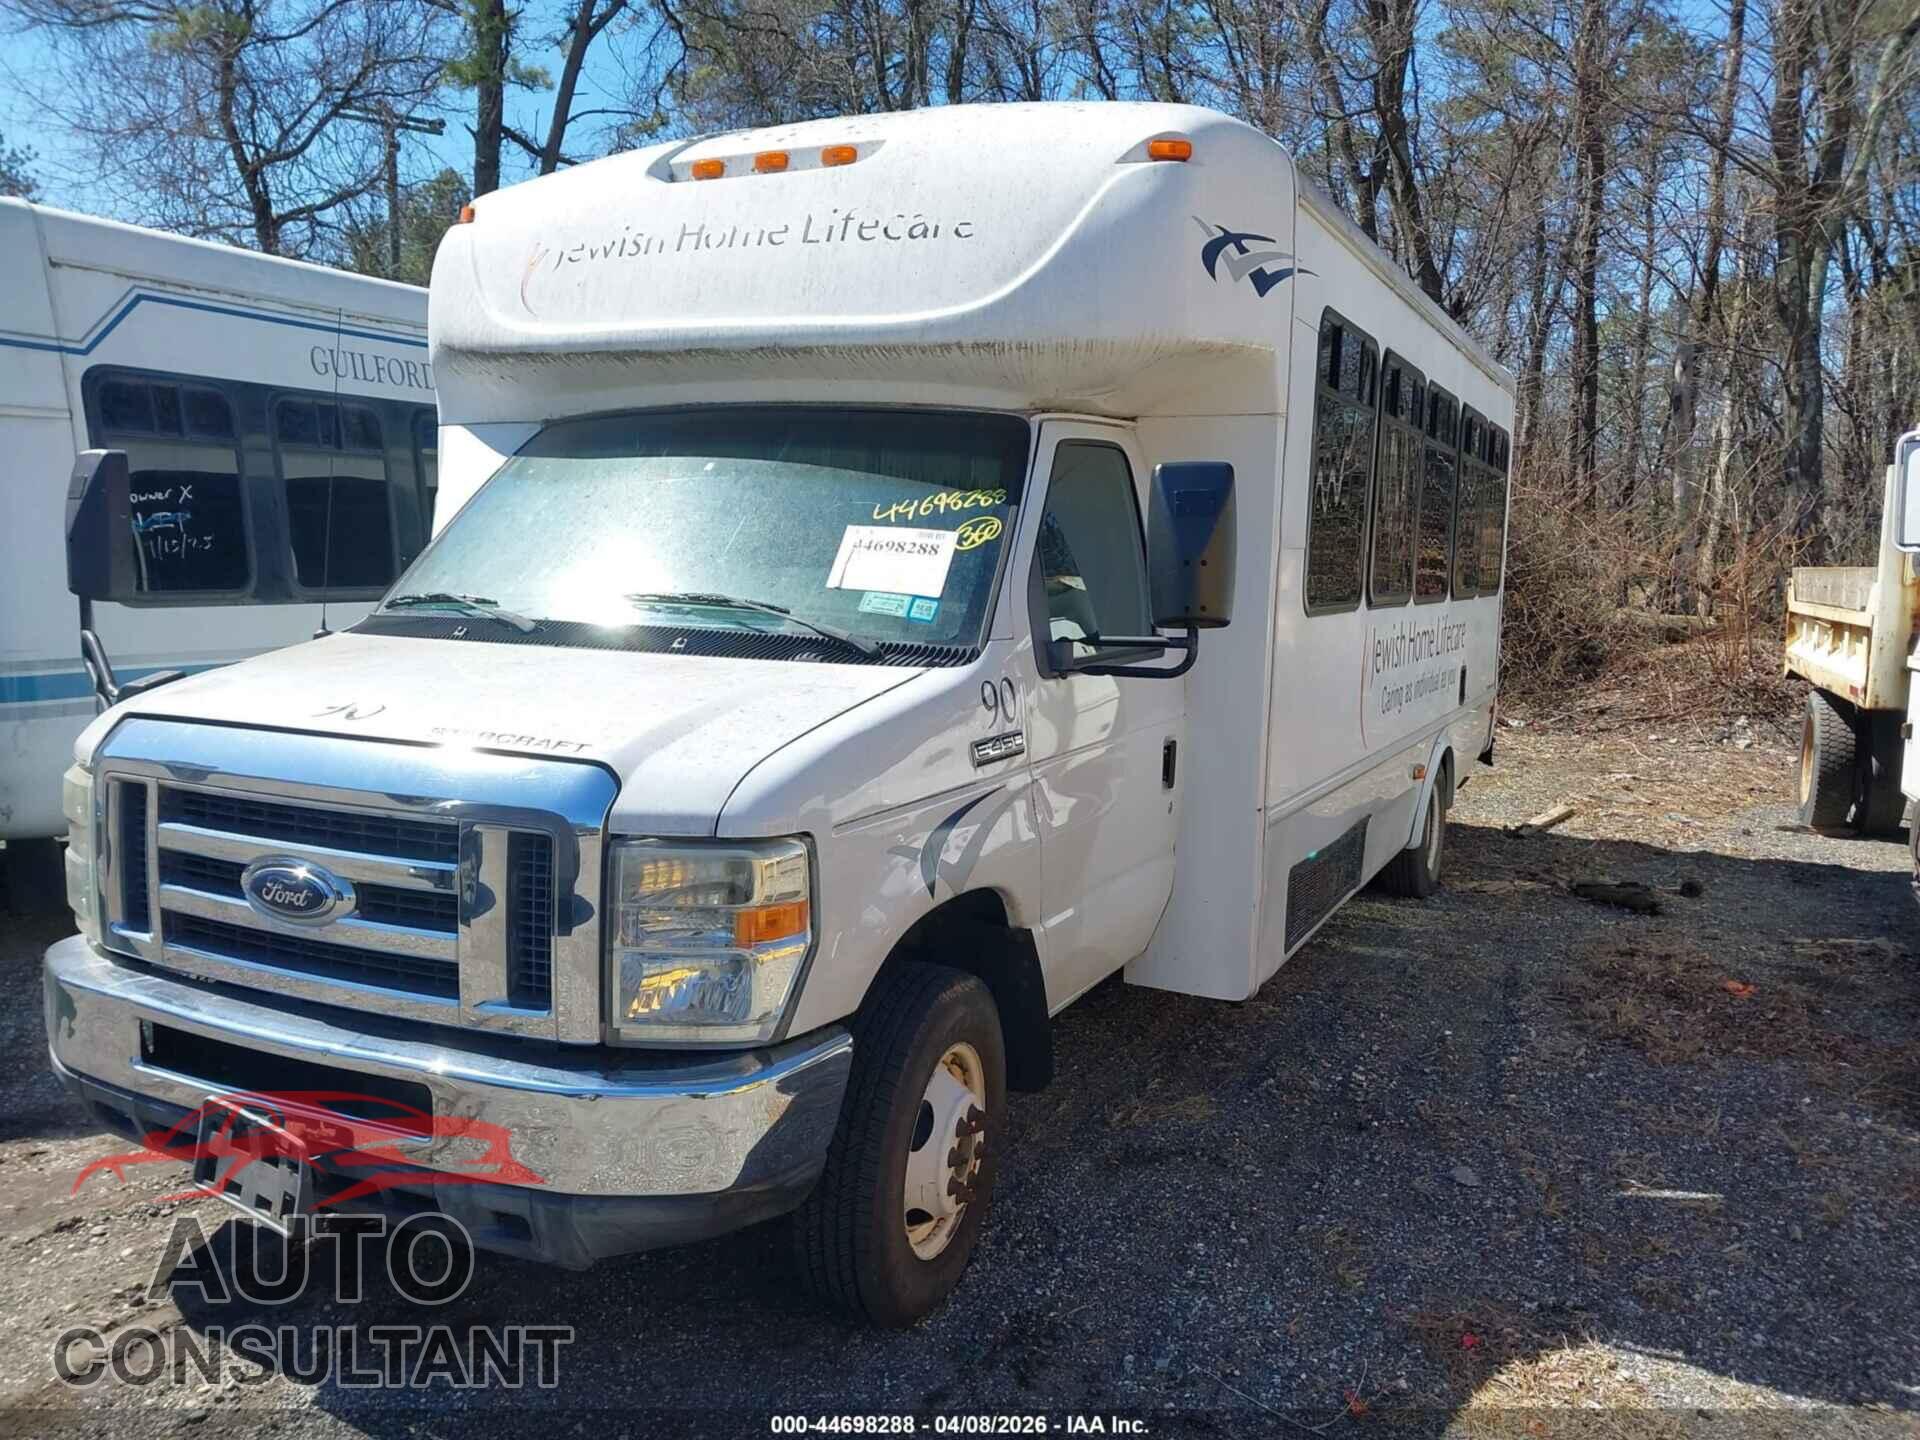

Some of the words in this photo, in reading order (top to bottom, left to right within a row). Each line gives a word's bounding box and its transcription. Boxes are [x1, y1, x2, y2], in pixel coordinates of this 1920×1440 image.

[1370, 621, 1406, 688] Jewish
[1407, 620, 1435, 664] Home
[981, 676, 1017, 729] 90
[261, 878, 309, 907] Ford
